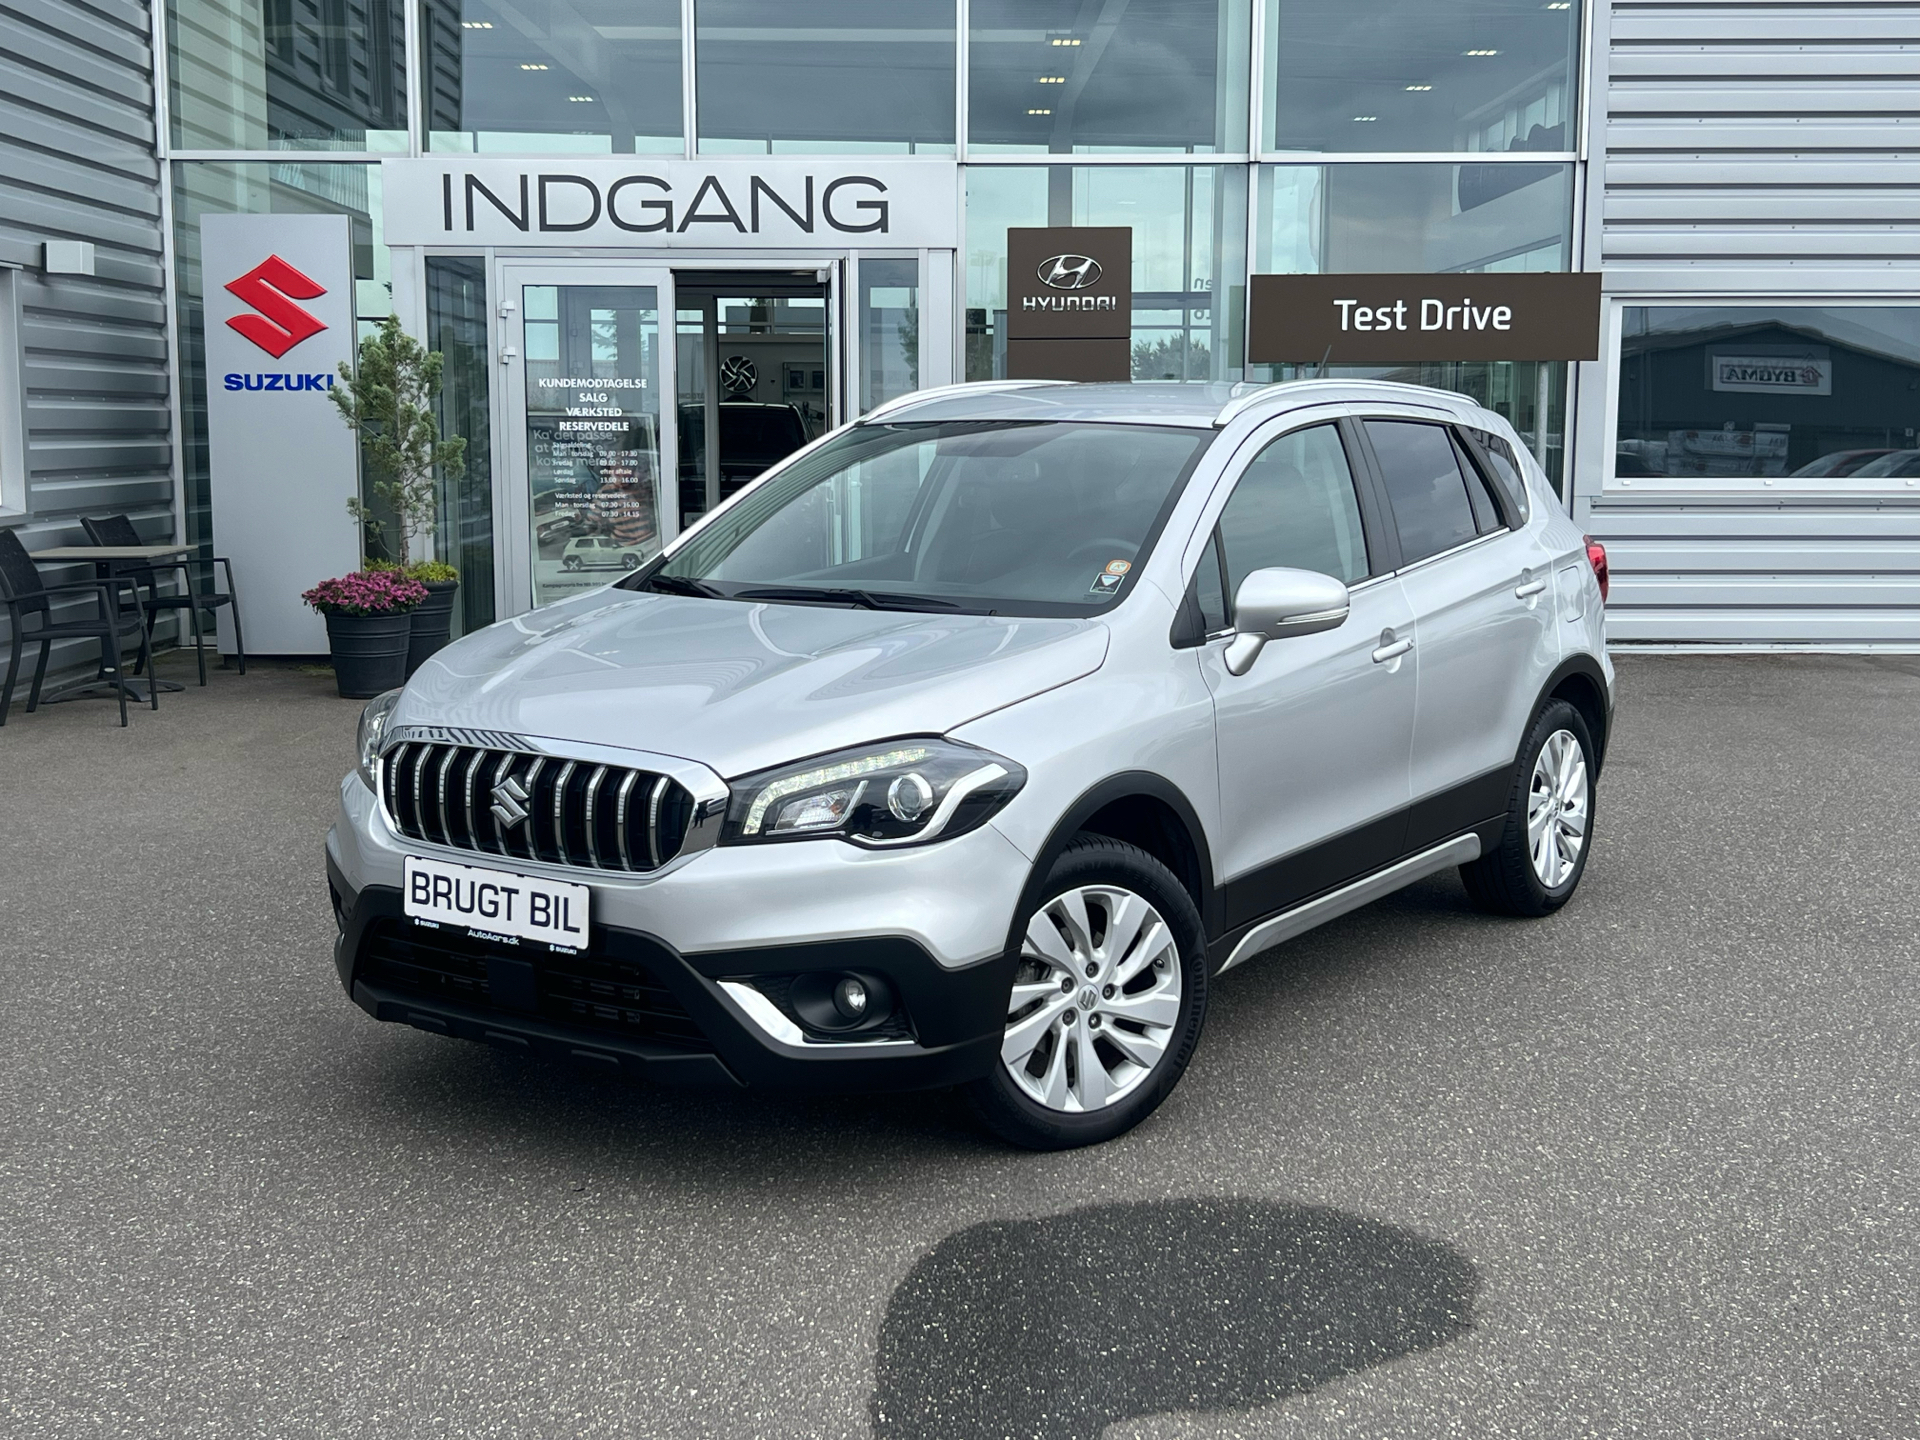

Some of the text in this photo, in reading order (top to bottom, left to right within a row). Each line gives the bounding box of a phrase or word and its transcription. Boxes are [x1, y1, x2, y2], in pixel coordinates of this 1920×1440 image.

[442, 173, 889, 233] INDGANG
[1022, 296, 1116, 312] HYUNDAI
[1333, 298, 1512, 331] Test Drive
[223, 373, 334, 391] SUZUKI
[538, 378, 647, 388] KUNDEMODTAGELSE
[579, 393, 608, 402] SALG
[566, 407, 622, 417] VÆRKSTED
[559, 421, 629, 431] RESERVEDELE
[554, 430, 574, 440] det
[534, 443, 549, 453] at
[411, 870, 581, 934] BRUGT BIL
[467, 929, 520, 946] AutoAars.dk
[1173, 952, 1205, 1070] Continental
